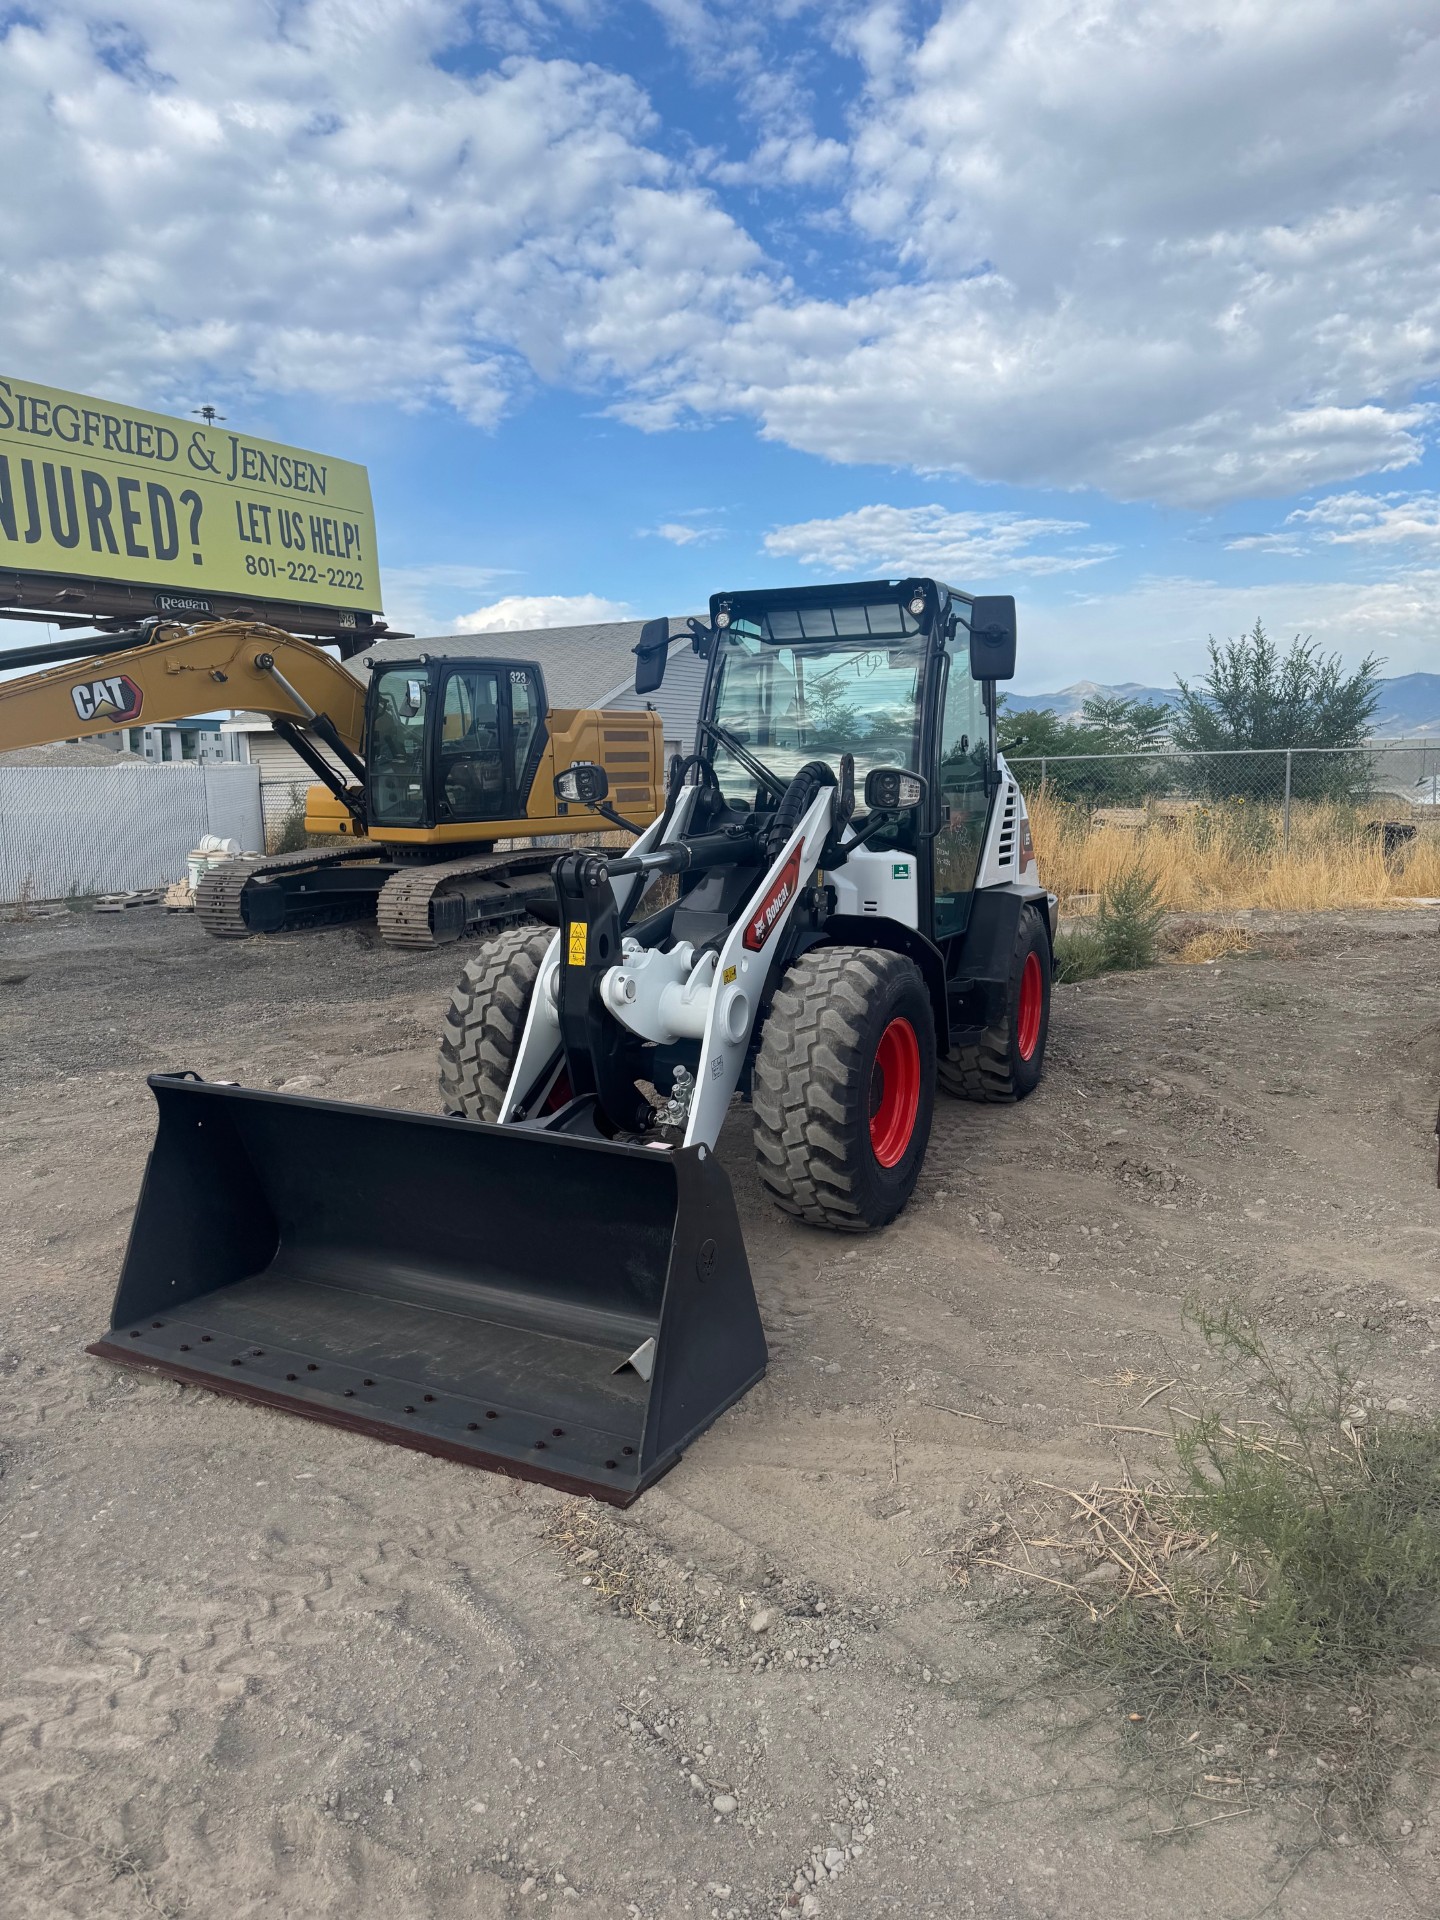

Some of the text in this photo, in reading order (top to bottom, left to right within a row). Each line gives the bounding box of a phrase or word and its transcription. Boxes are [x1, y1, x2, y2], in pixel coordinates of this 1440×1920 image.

[0, 380, 328, 496] SIEGFRIED & JENSEN
[235, 500, 362, 561] LET US HELP!
[245, 554, 365, 591] 801-222-2222
[160, 596, 210, 611] Reagan
[71, 676, 126, 720] CAT
[509, 671, 526, 684] 323
[765, 882, 789, 926] Bobcat
